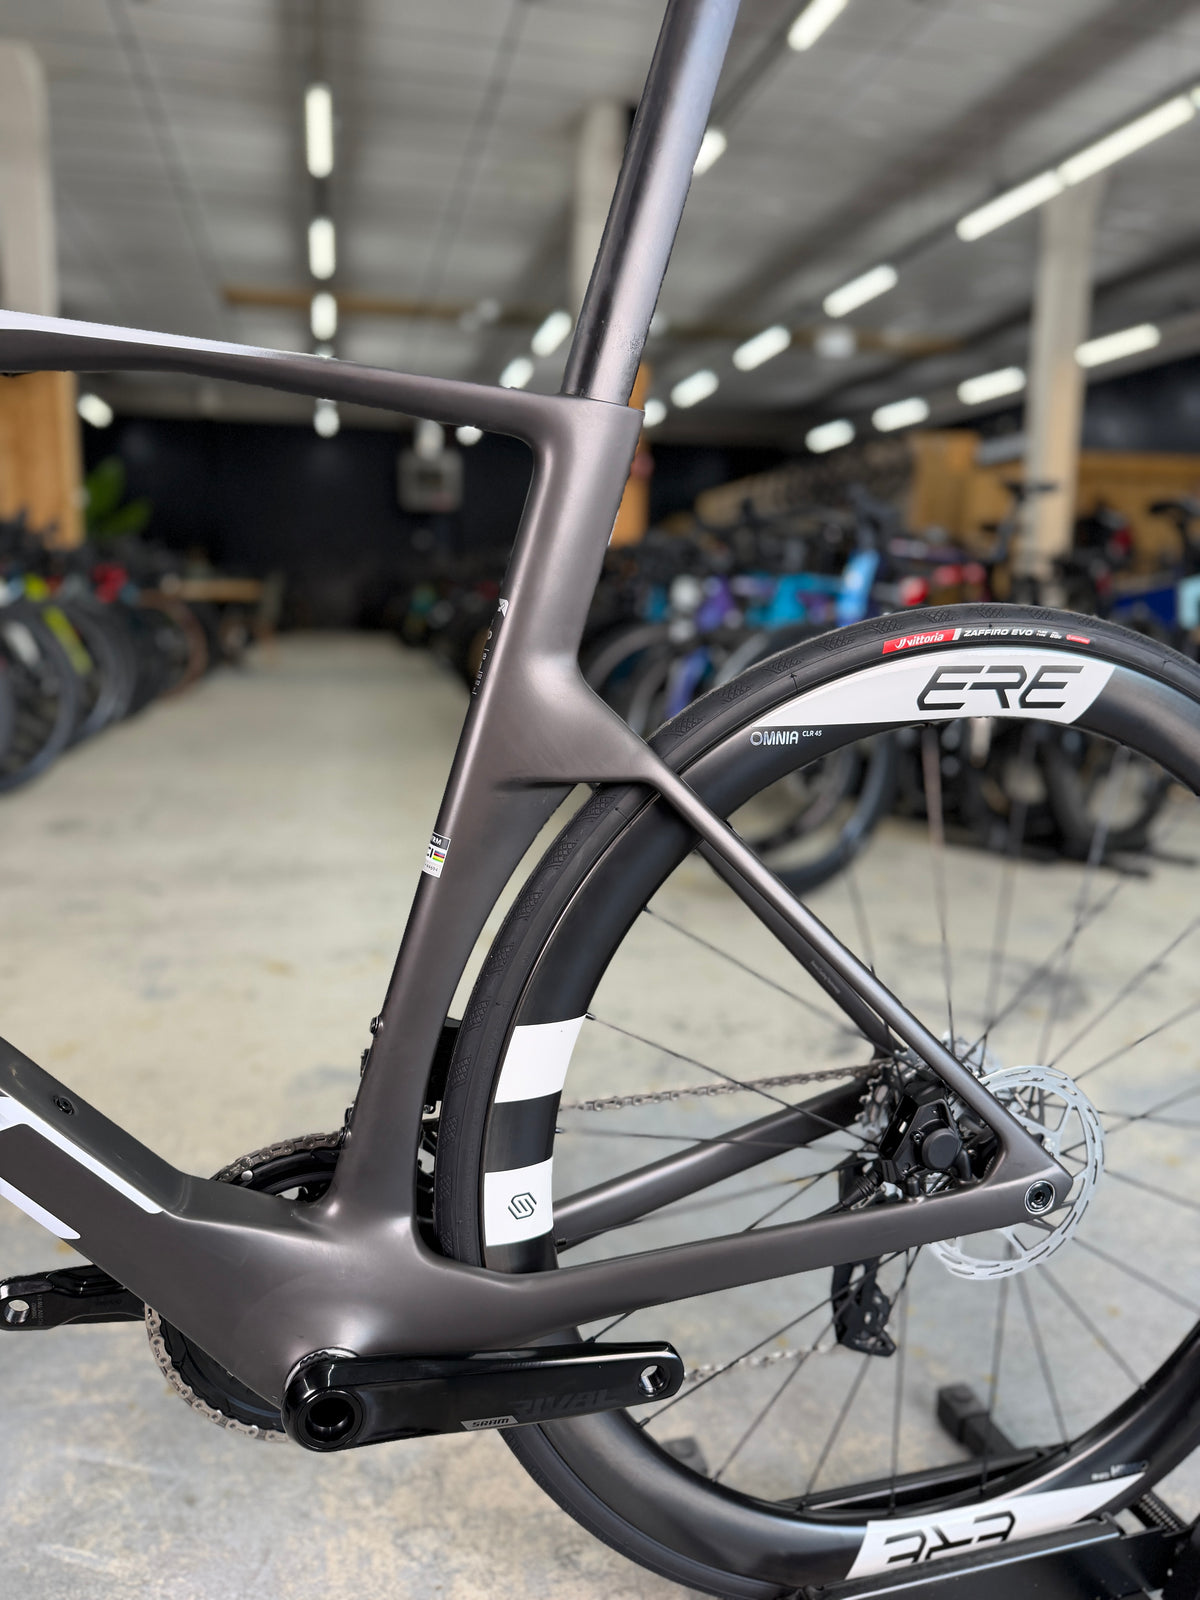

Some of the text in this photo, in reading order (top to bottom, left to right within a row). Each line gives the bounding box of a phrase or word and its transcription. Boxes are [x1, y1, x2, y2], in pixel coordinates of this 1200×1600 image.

[906, 632, 945, 646] vittoria
[963, 628, 1010, 637] ZAFFIRO
[1011, 628, 1034, 636] EVO
[917, 665, 1084, 711] ERE
[750, 730, 799, 746] OMNIA
[472, 1418, 510, 1428] SRAM
